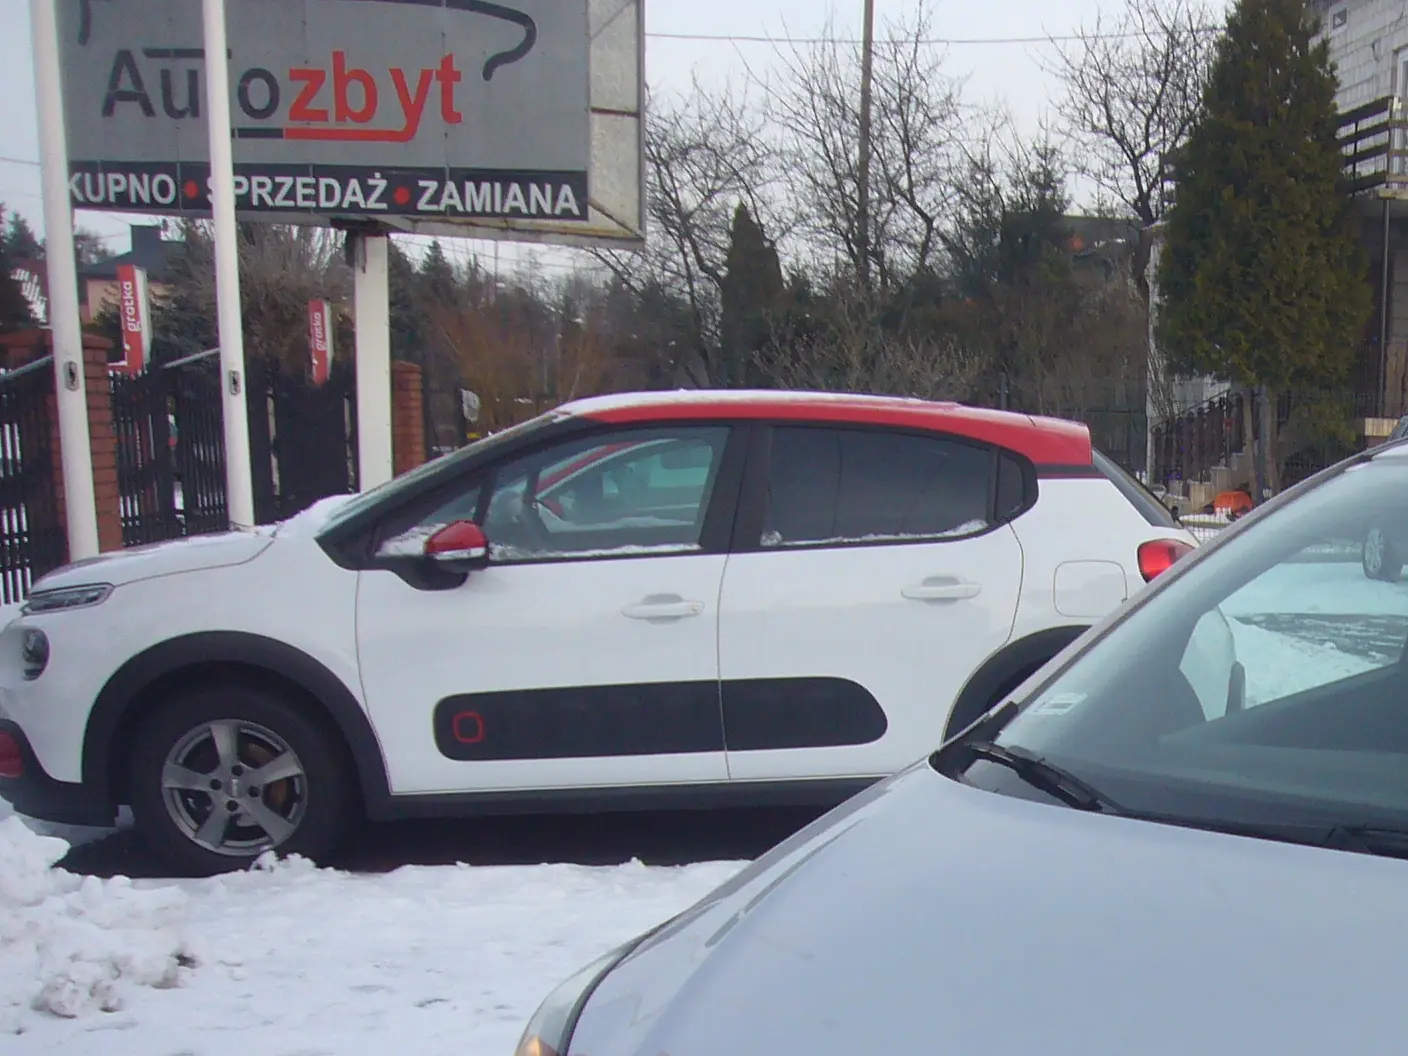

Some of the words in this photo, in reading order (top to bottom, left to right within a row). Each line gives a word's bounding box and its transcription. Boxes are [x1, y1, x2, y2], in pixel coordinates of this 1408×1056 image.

[69, 172, 177, 204] KUPNO
[206, 172, 389, 210] PRZEDAŻ
[416, 179, 581, 216] ZAMIANA
[122, 281, 142, 332] gratka
